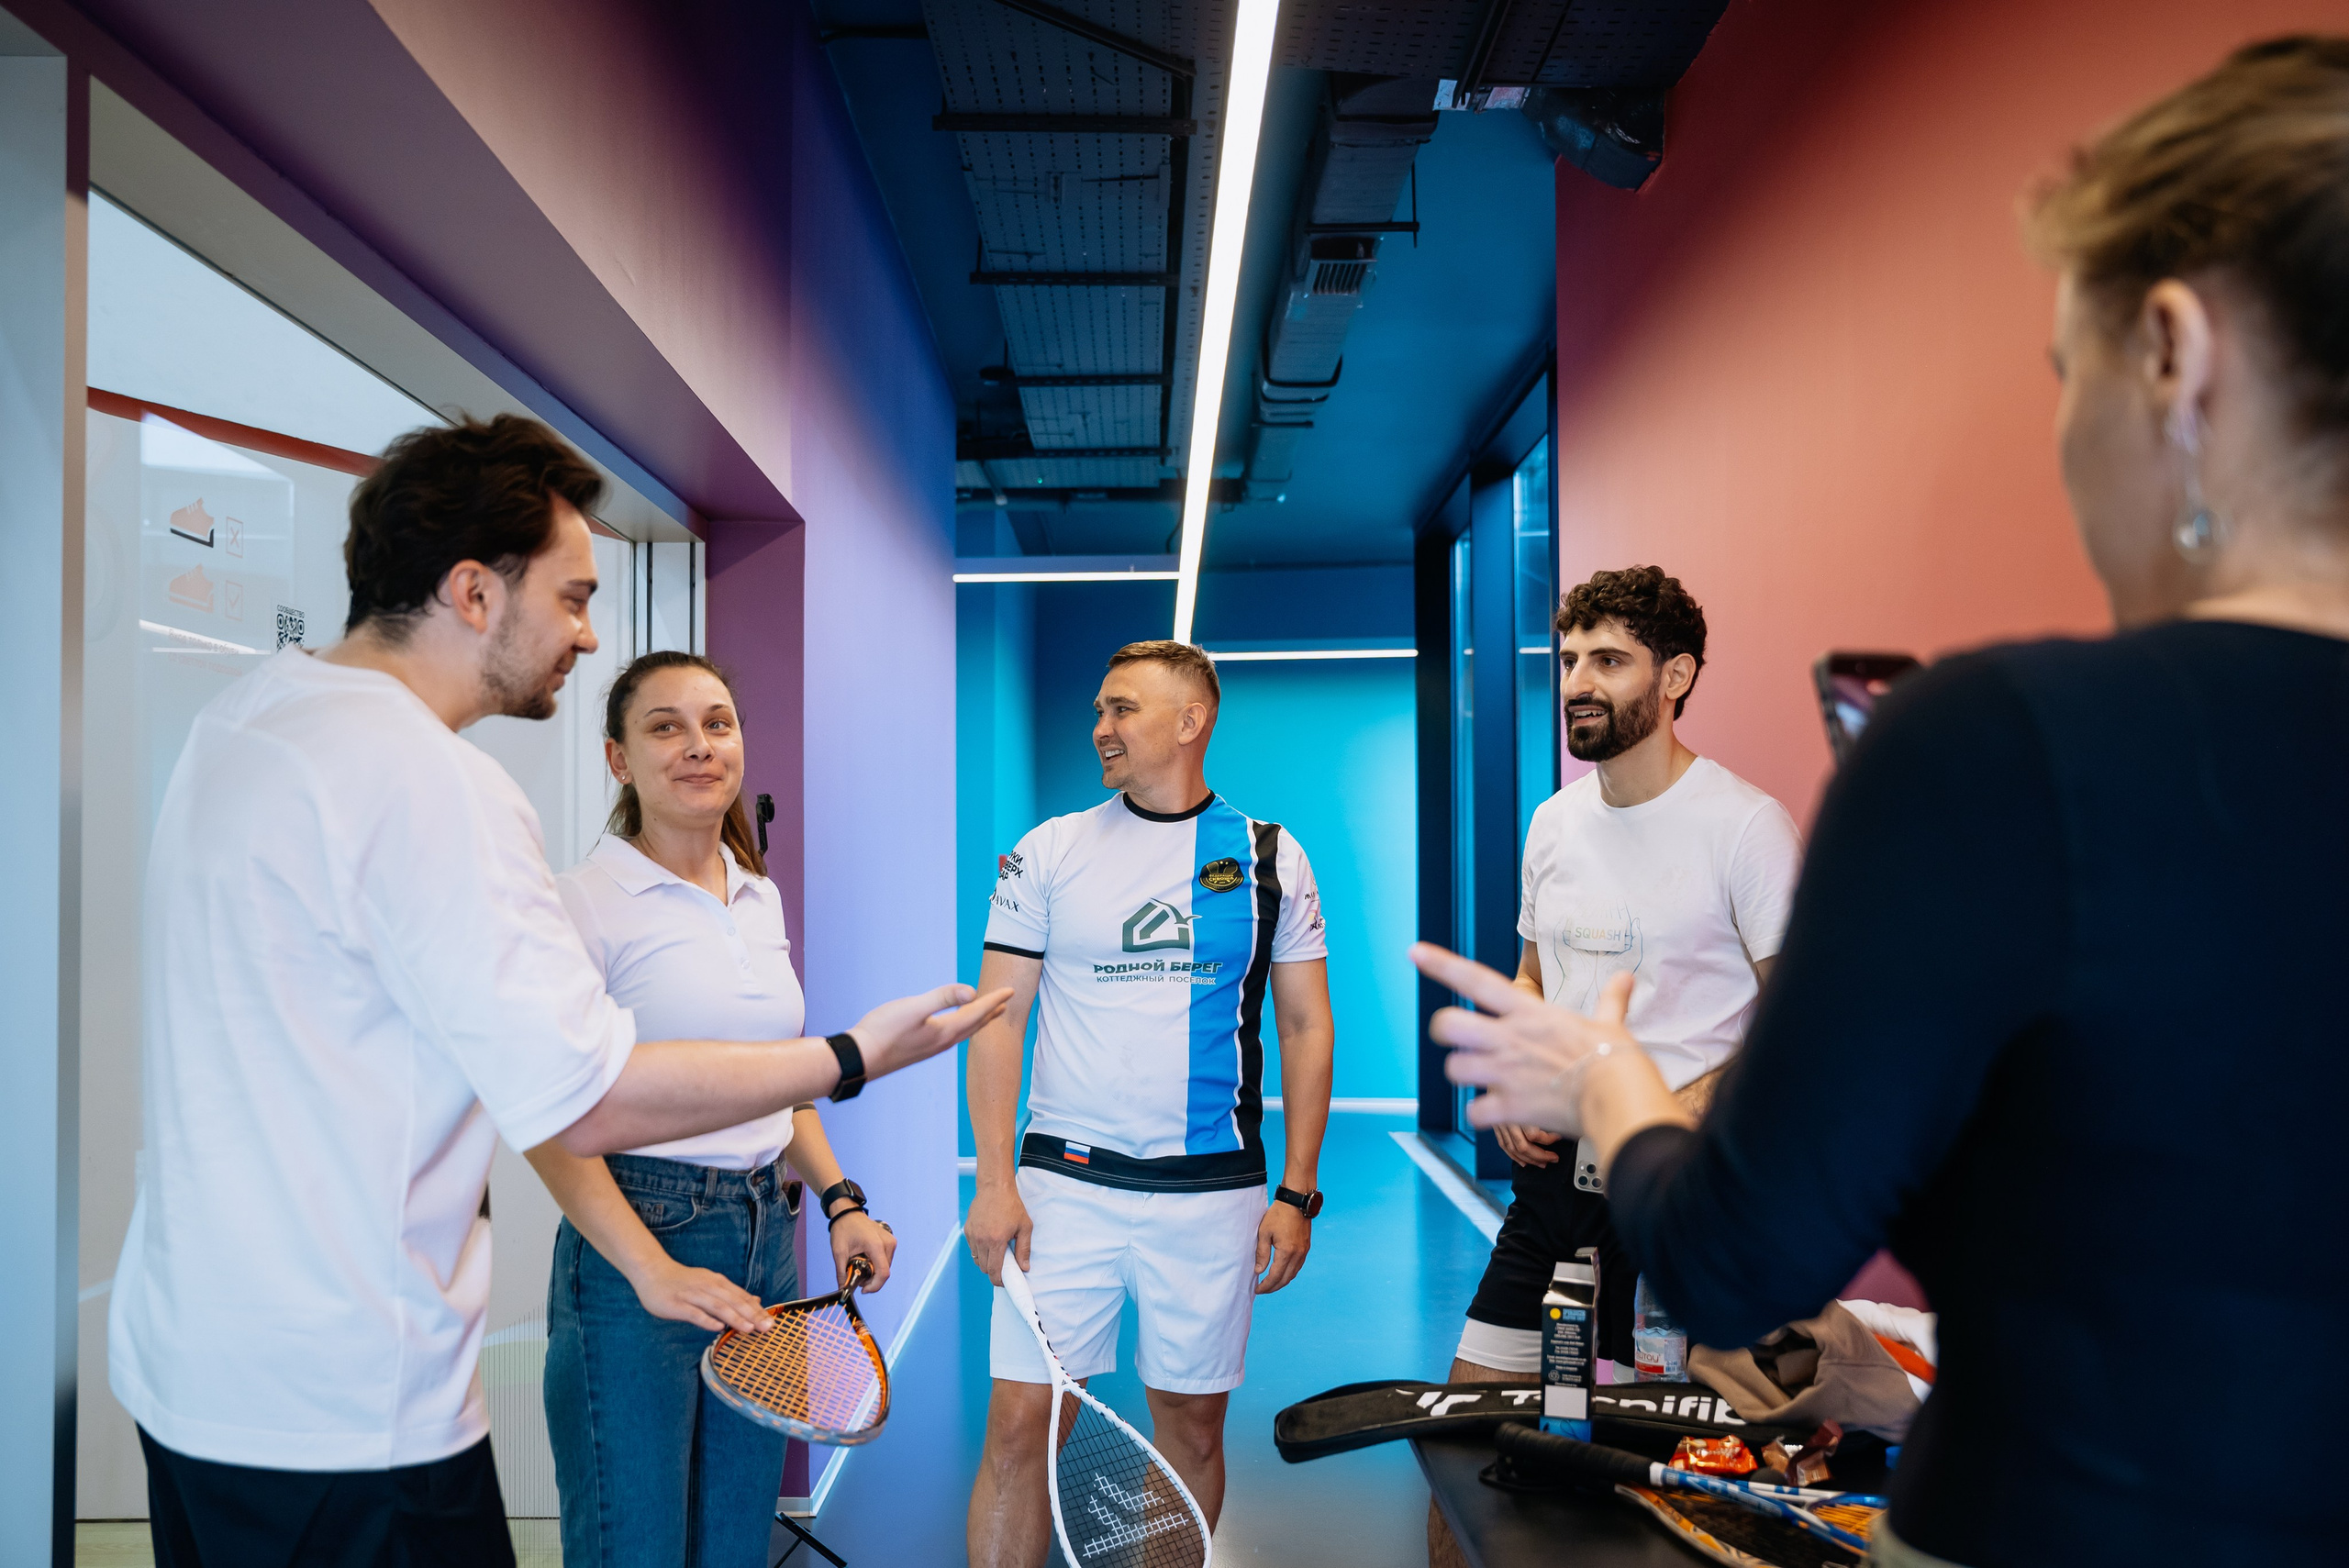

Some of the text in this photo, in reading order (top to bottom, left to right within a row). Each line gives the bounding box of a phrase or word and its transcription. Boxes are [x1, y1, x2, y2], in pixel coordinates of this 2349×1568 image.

[277, 605, 305, 618] СООБЩЕСТВО
[1575, 927, 1621, 941] SQUASH
[1093, 959, 1223, 973] РОДНОЙ БЕРЕГ
[1097, 974, 1217, 985] КОТТЕДЖНЫЙ ПОСЕЛОК
